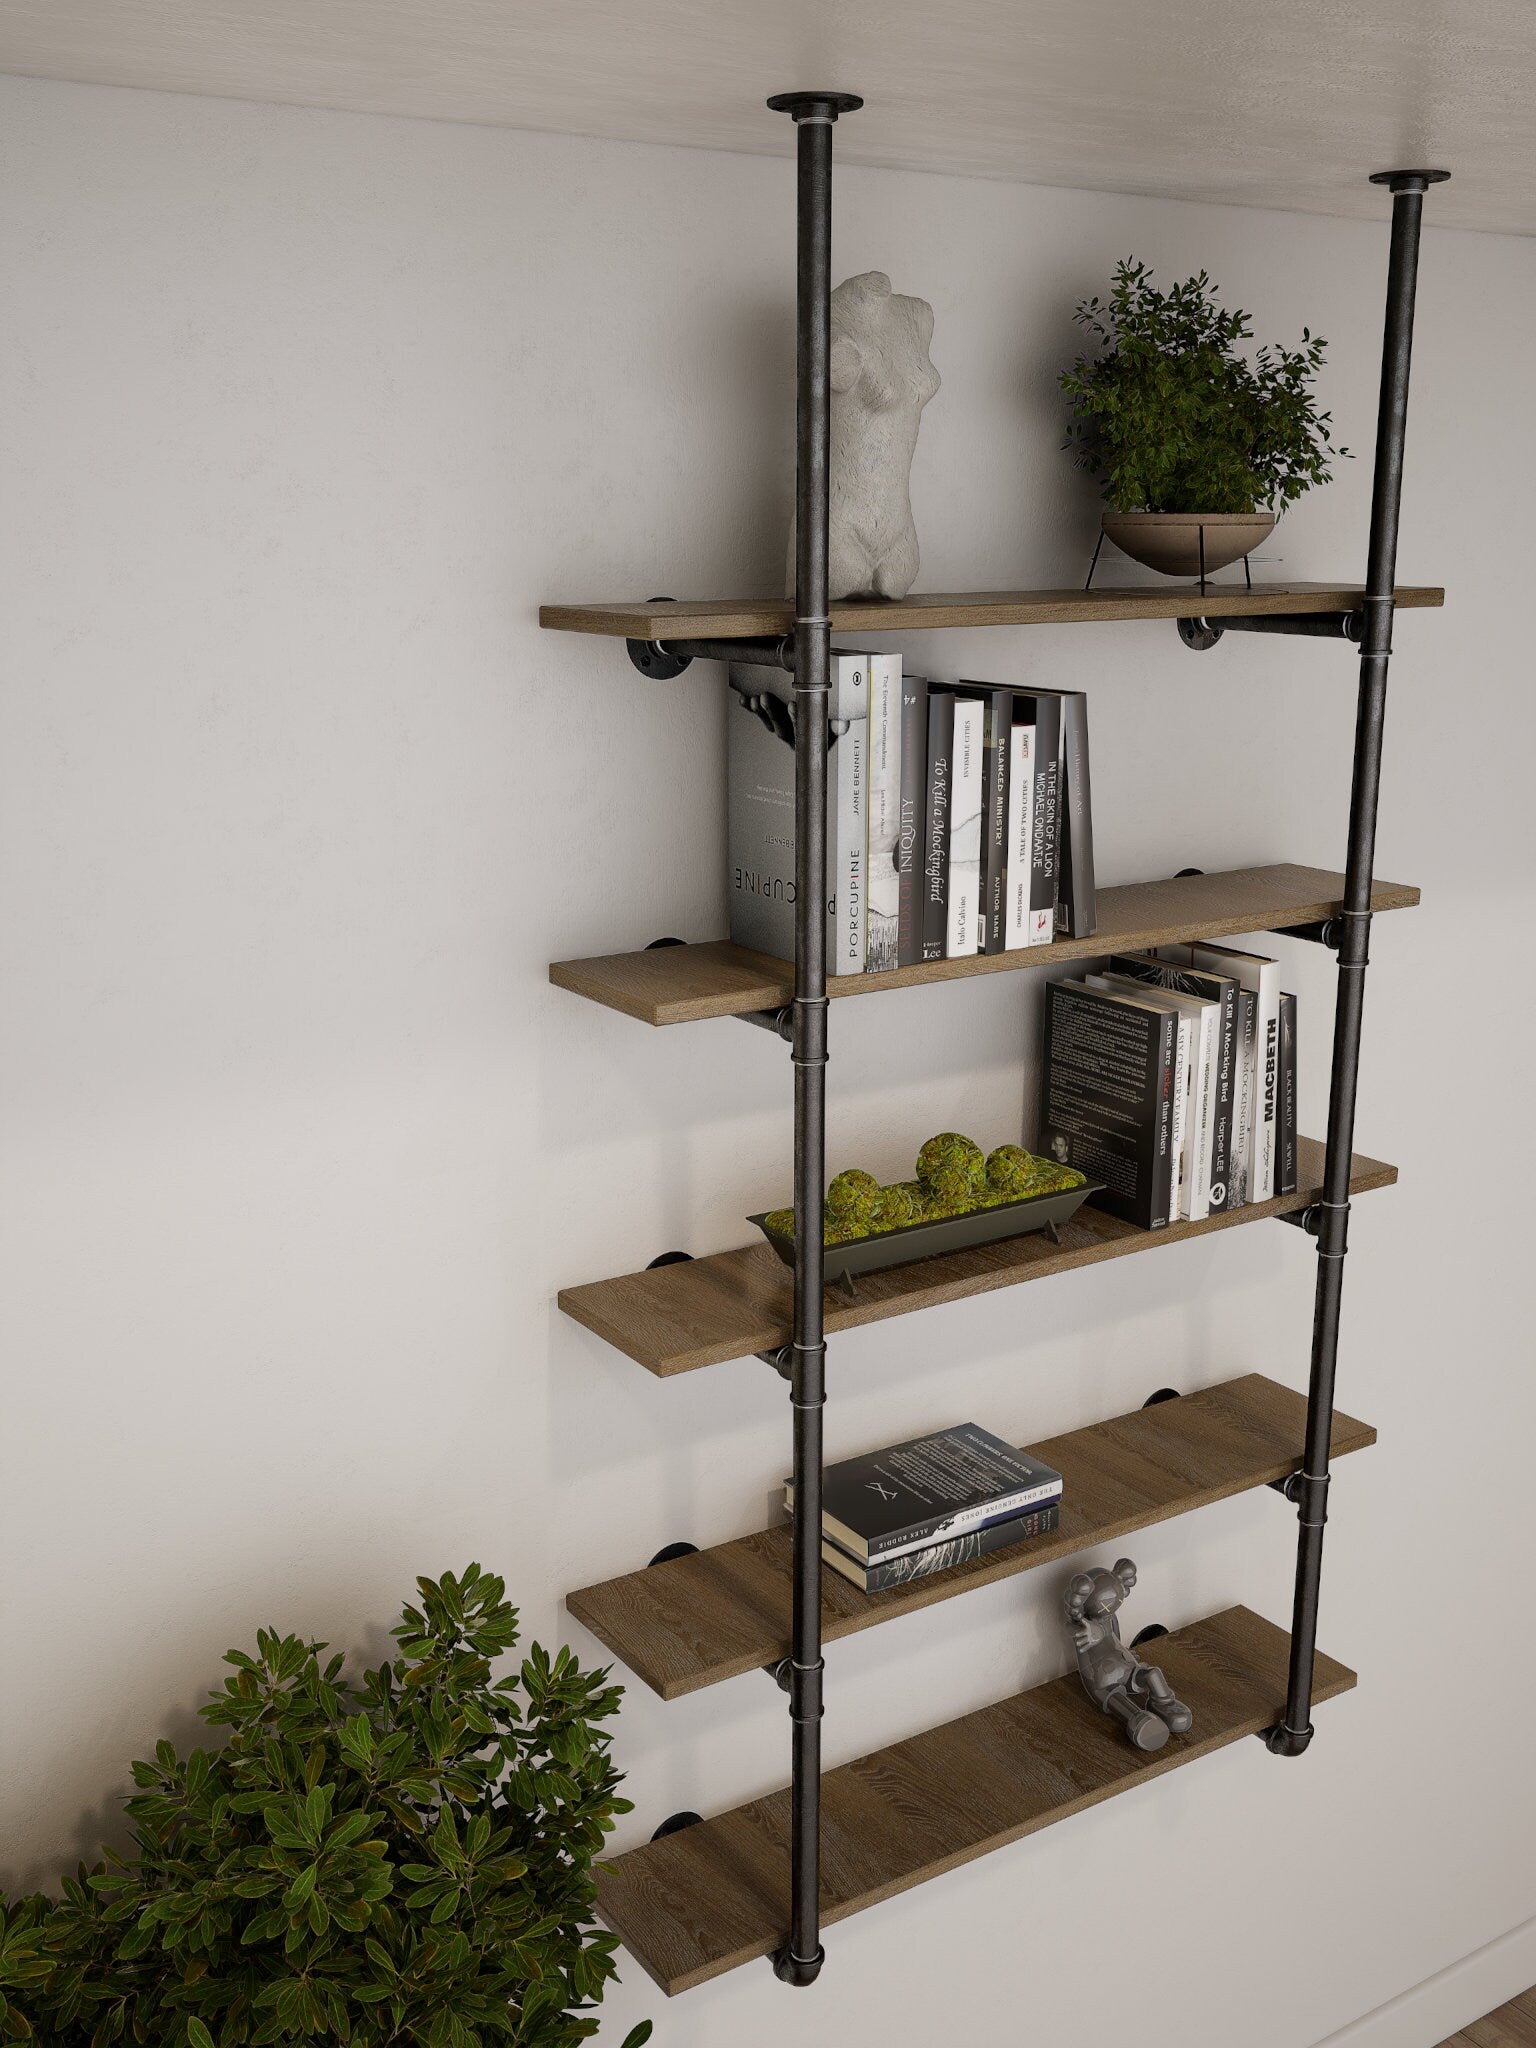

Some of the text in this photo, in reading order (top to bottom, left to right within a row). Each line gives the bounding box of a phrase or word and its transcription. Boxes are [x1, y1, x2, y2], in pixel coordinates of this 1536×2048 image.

[903, 694, 917, 706] #4
[995, 738, 1006, 846] BALANCED MINISTRY
[901, 798, 916, 873] INIQUITY
[925, 758, 948, 904] To Kill a Mockingbird
[1020, 826, 1027, 837] OF
[1033, 773, 1046, 868] MICHAEL ONDAATJE
[1044, 761, 1057, 878] IN THE SKIN OF A LION
[849, 850, 860, 957] PORCUPINE
[993, 876, 1001, 911] AUTHOR
[957, 896, 967, 945] Italo Calvino
[922, 949, 941, 959] Lee
[1246, 996, 1254, 1017] TO
[1220, 988, 1235, 1103] To Kill A Mocking Bird
[1244, 1020, 1252, 1047] KILL
[1163, 1066, 1172, 1099] sicker
[1175, 1052, 1184, 1102] CENTURY
[1264, 1018, 1277, 1123] MACBETH
[1162, 1100, 1170, 1124] than
[1238, 1062, 1249, 1154] MOCKINGBIRD
[1160, 1124, 1168, 1156] others
[1216, 1116, 1226, 1172] Harper LEE
[961, 1508, 983, 1522] JONES
[1019, 1492, 1037, 1502] ONLY
[878, 1527, 929, 1549] ALEX RODDIE
